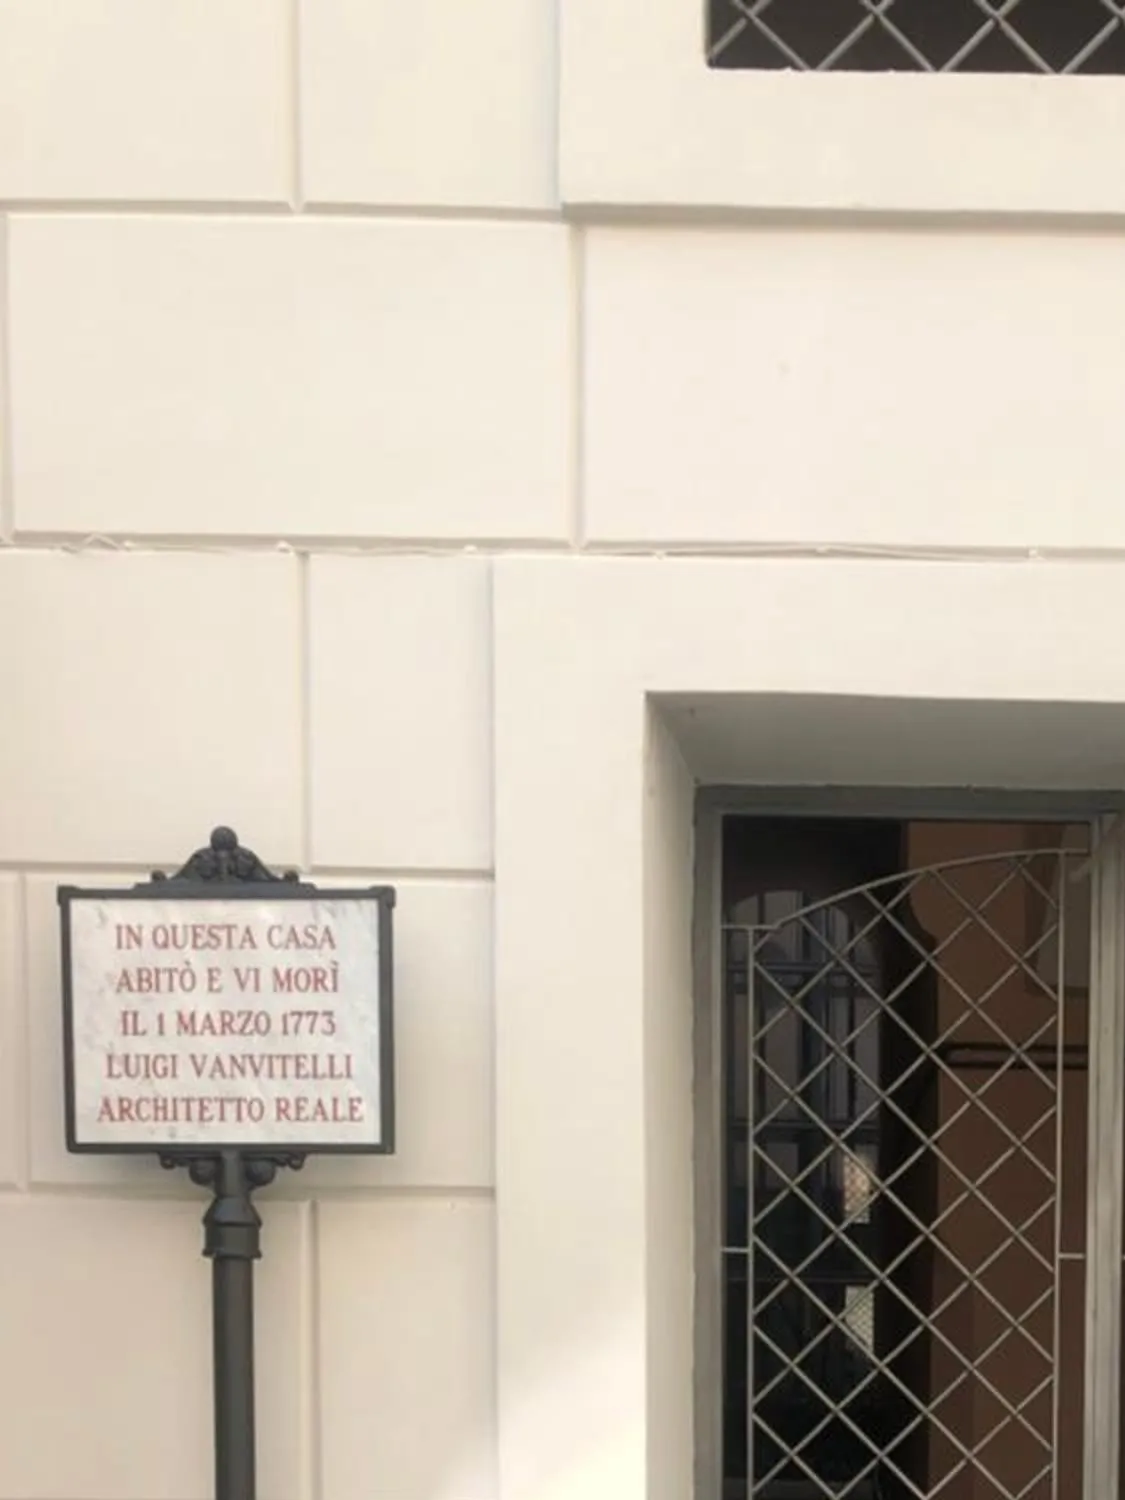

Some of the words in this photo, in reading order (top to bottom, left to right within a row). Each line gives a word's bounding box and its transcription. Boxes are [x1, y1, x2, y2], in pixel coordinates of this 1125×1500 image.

[115, 924, 143, 950] IN
[151, 924, 258, 951] QUESTA
[266, 925, 337, 950] CASA
[115, 962, 197, 994] ABITÒ
[207, 968, 222, 993] E
[233, 968, 261, 993] VI
[272, 961, 339, 993] MORÌ
[120, 1011, 147, 1037] IL
[156, 1011, 165, 1036] 1
[176, 1011, 272, 1037] MARZO
[281, 1010, 337, 1037] 1773
[105, 1054, 178, 1080] LUIGI
[189, 1054, 353, 1080] VANVITELLI
[96, 1097, 265, 1123] ARCHITETTO
[275, 1098, 364, 1123] REALE
